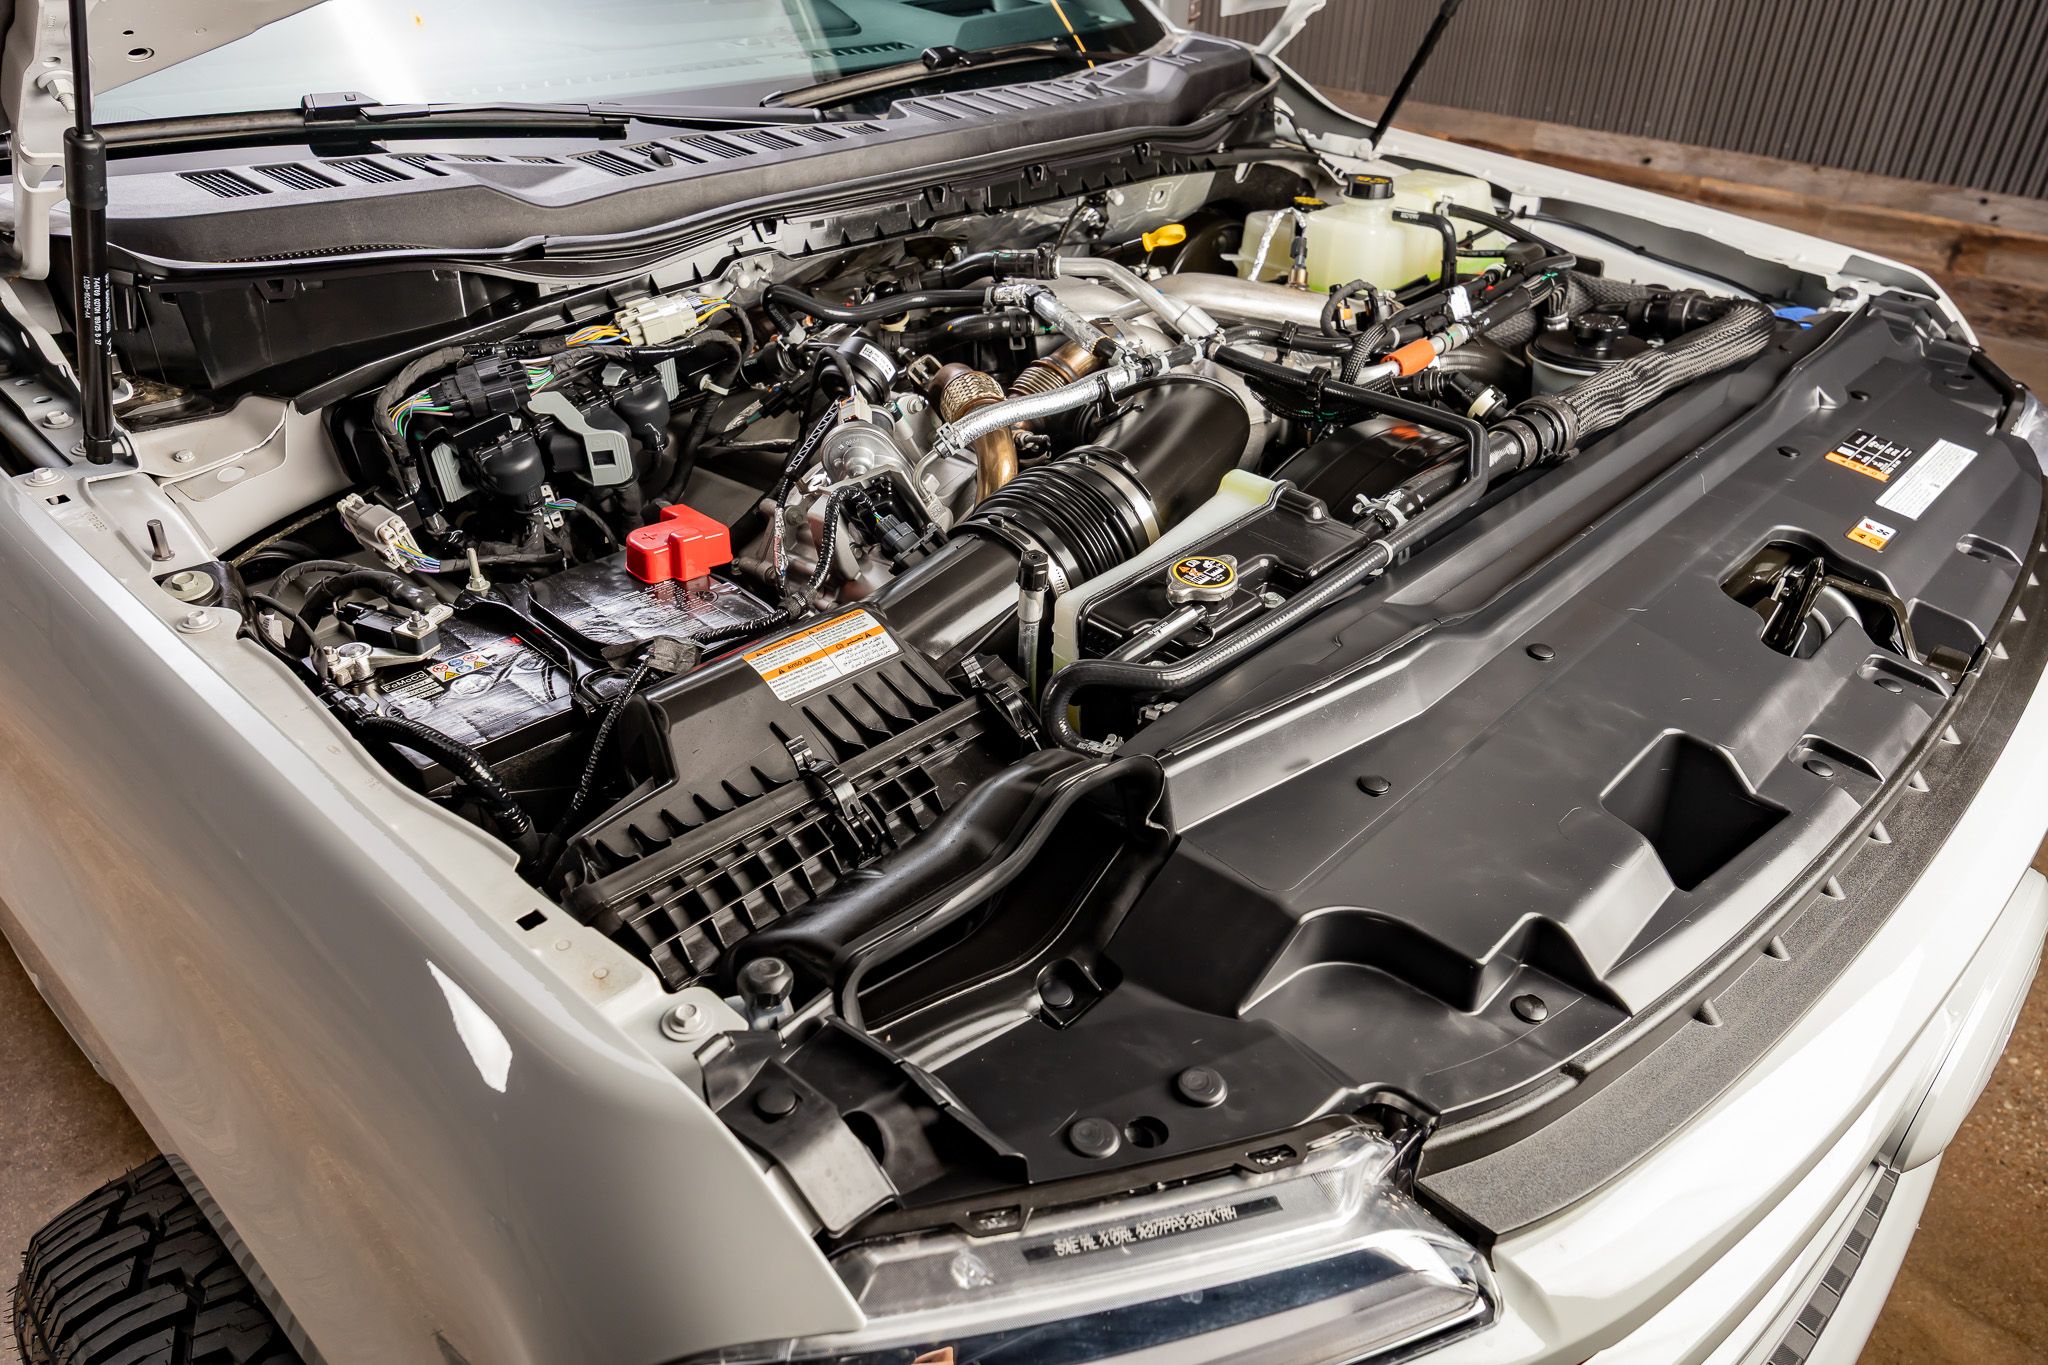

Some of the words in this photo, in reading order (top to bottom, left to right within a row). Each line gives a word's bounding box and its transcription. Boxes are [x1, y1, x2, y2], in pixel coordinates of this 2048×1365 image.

[763, 642, 787, 654] WARNING
[787, 661, 803, 670] AVISO
[384, 674, 425, 691] FoMoCo
[1054, 1237, 1081, 1257] SAE
[1111, 1226, 1137, 1246] DRL
[1219, 1205, 1238, 1222] RH
